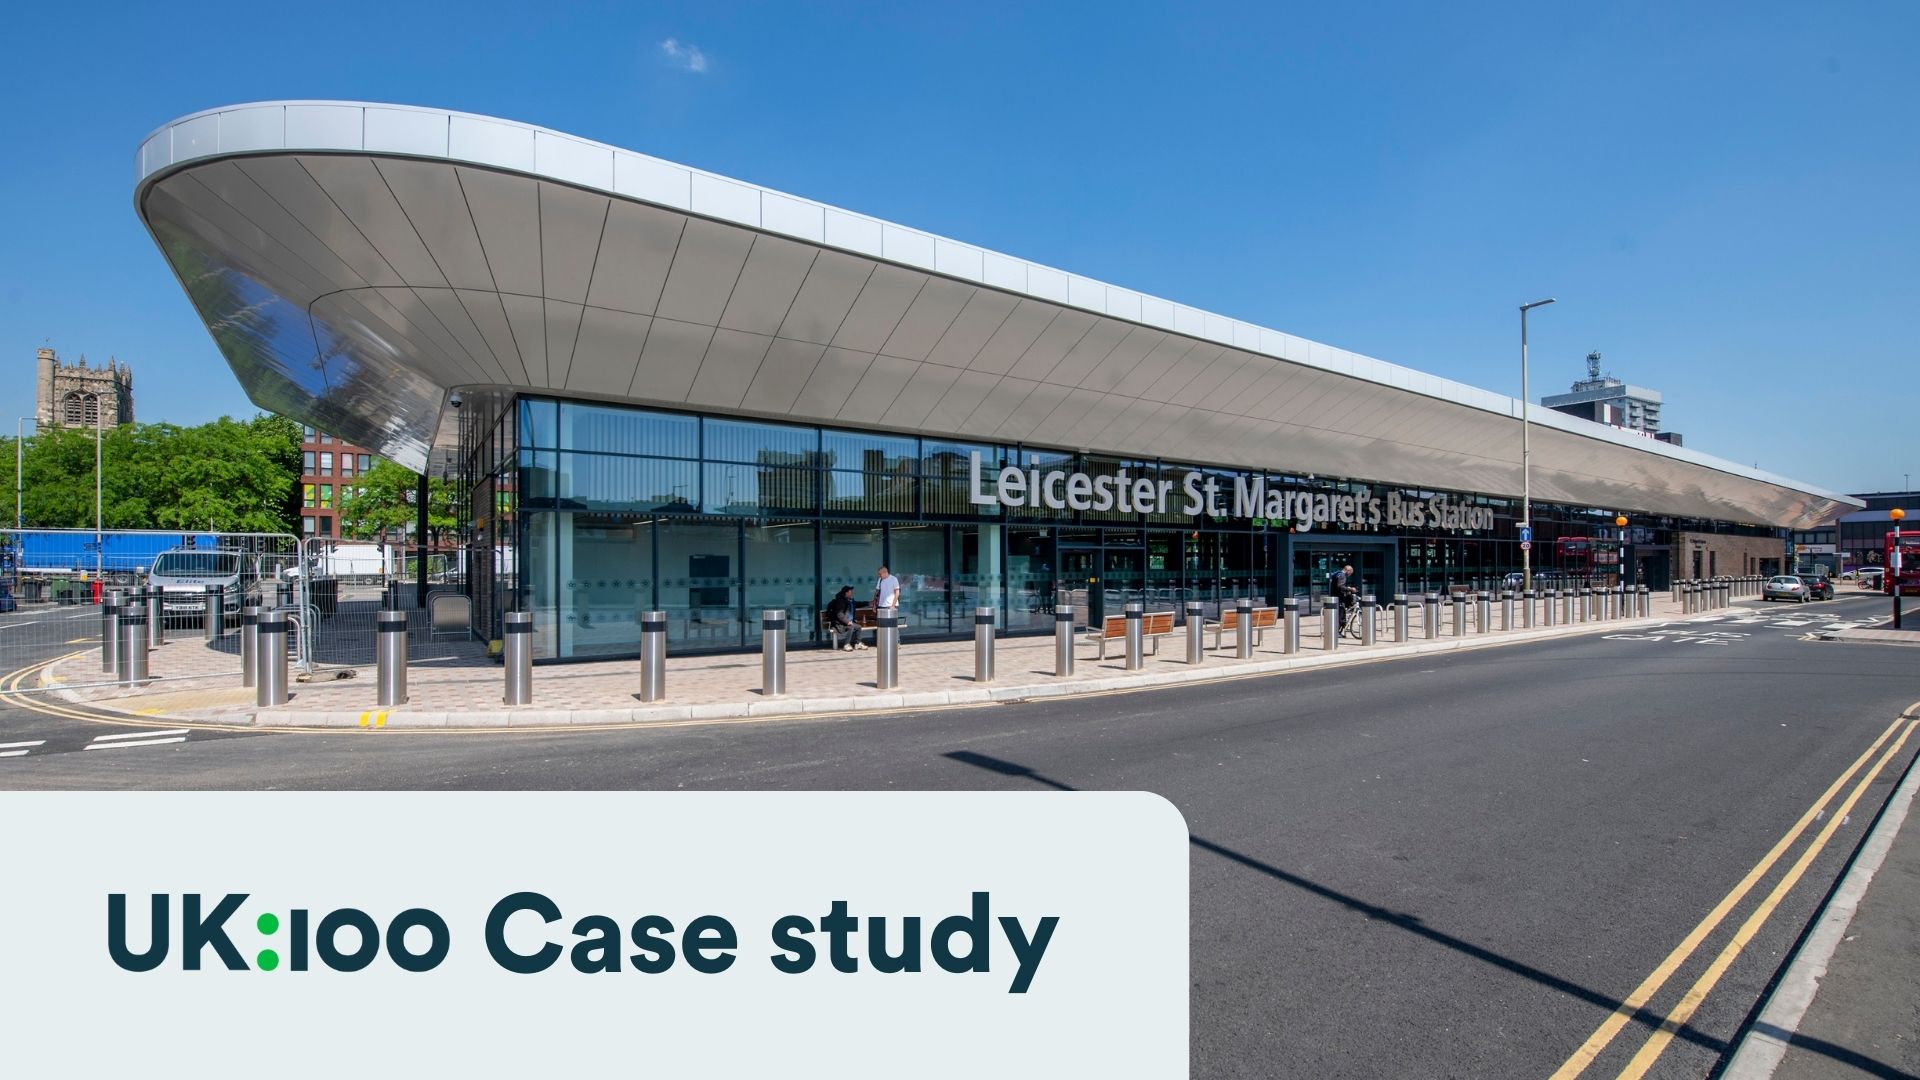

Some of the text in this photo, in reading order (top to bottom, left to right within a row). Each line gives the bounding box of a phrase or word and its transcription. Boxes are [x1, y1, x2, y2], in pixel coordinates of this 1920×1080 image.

[970, 451, 1494, 532] Leicester St. Margaret's Bus Station
